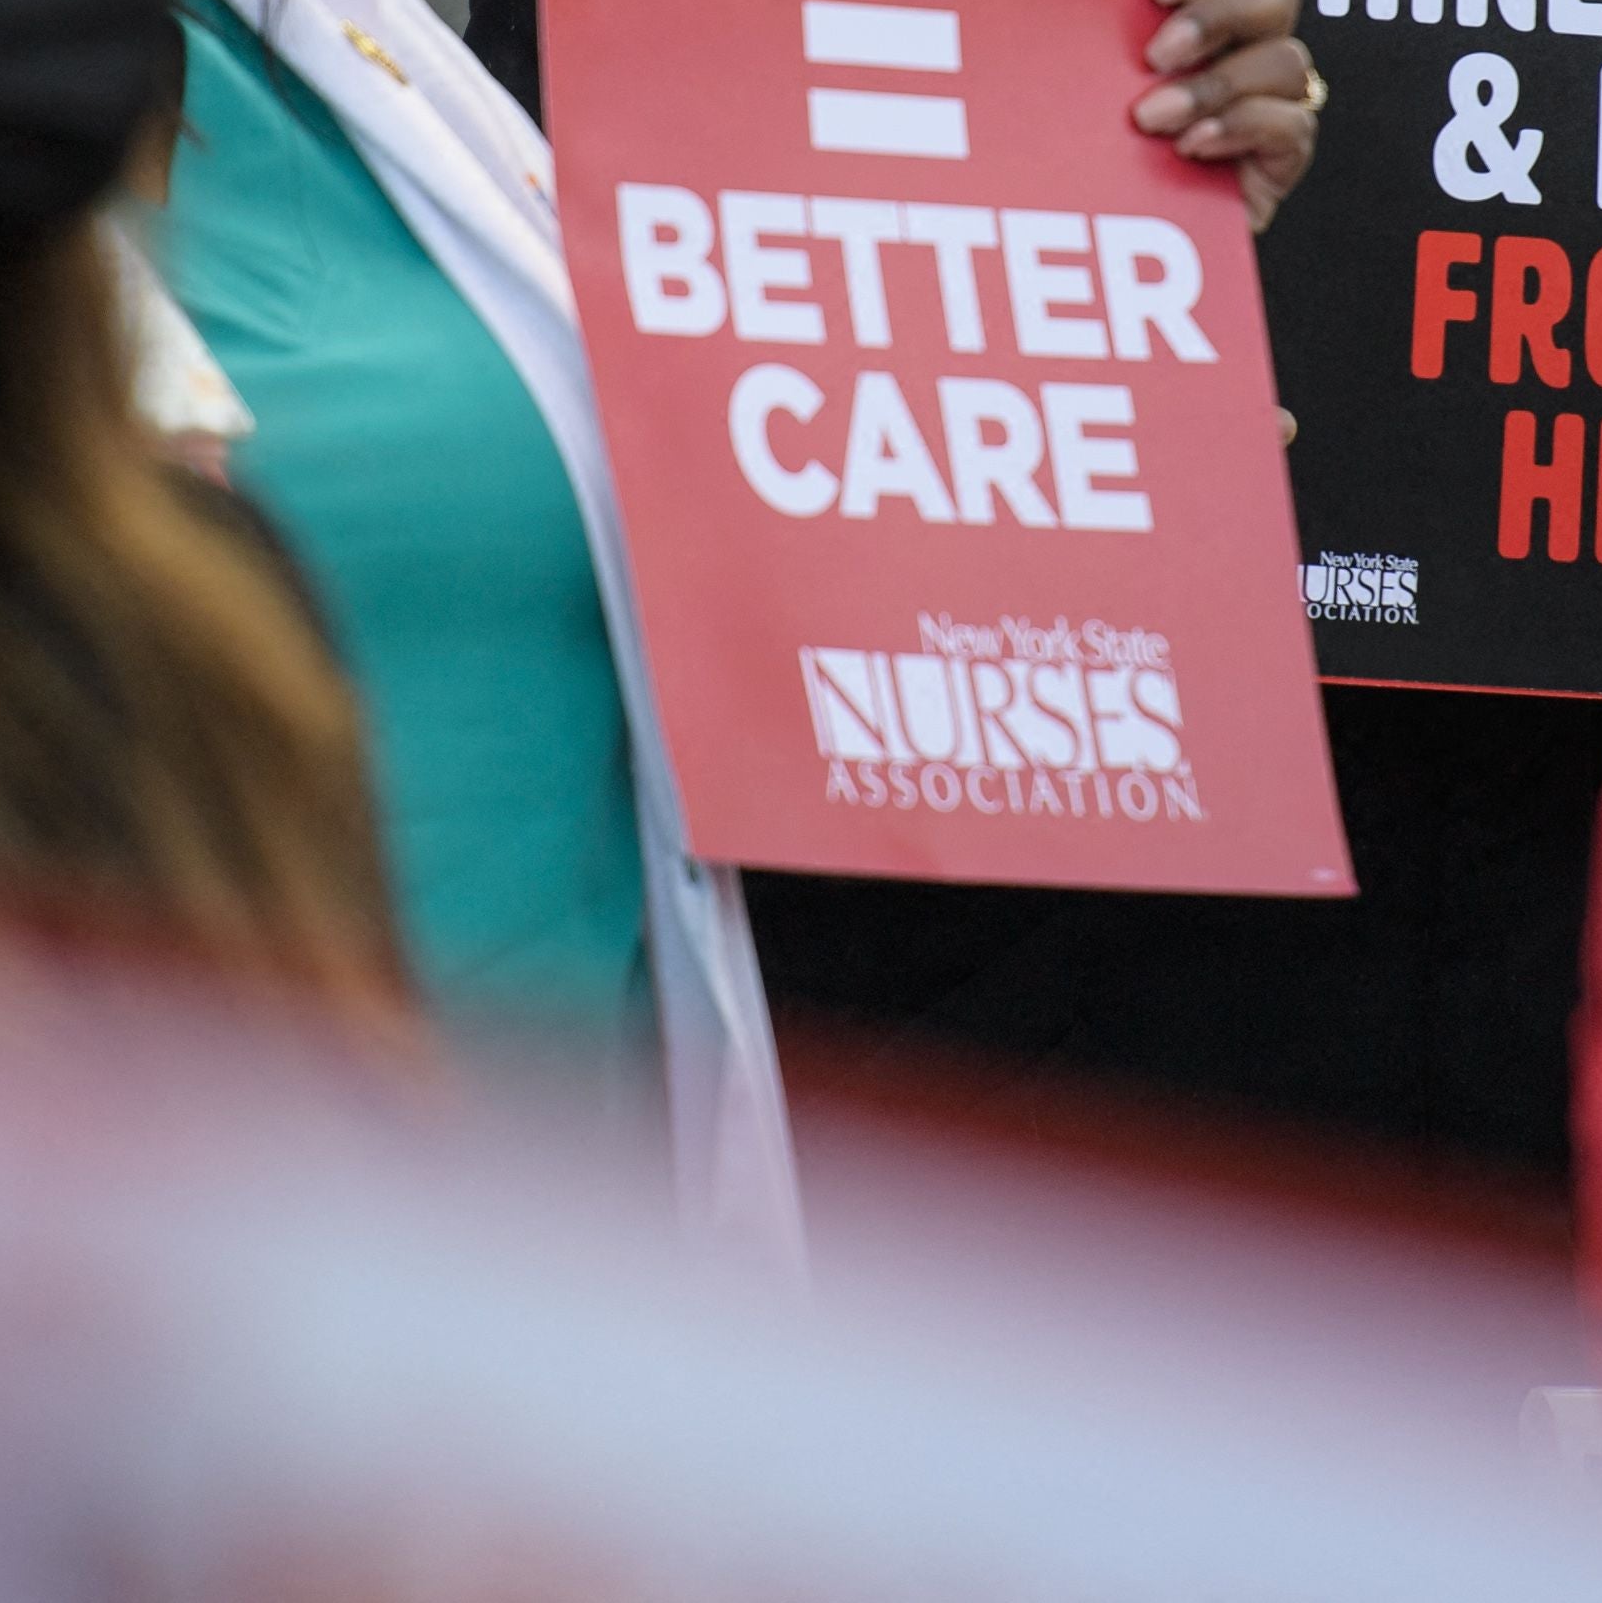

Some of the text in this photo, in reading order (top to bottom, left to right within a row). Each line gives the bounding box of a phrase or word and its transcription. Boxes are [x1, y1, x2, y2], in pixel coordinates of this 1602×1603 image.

[1432, 51, 1544, 205] &
[614, 181, 1220, 364] BETTER
[727, 361, 1155, 533] CARE
[1319, 550, 1419, 572] New York State
[916, 609, 1171, 668] New York State
[798, 644, 1193, 775] NURSES
[825, 758, 1204, 823] ASSOCIATION
